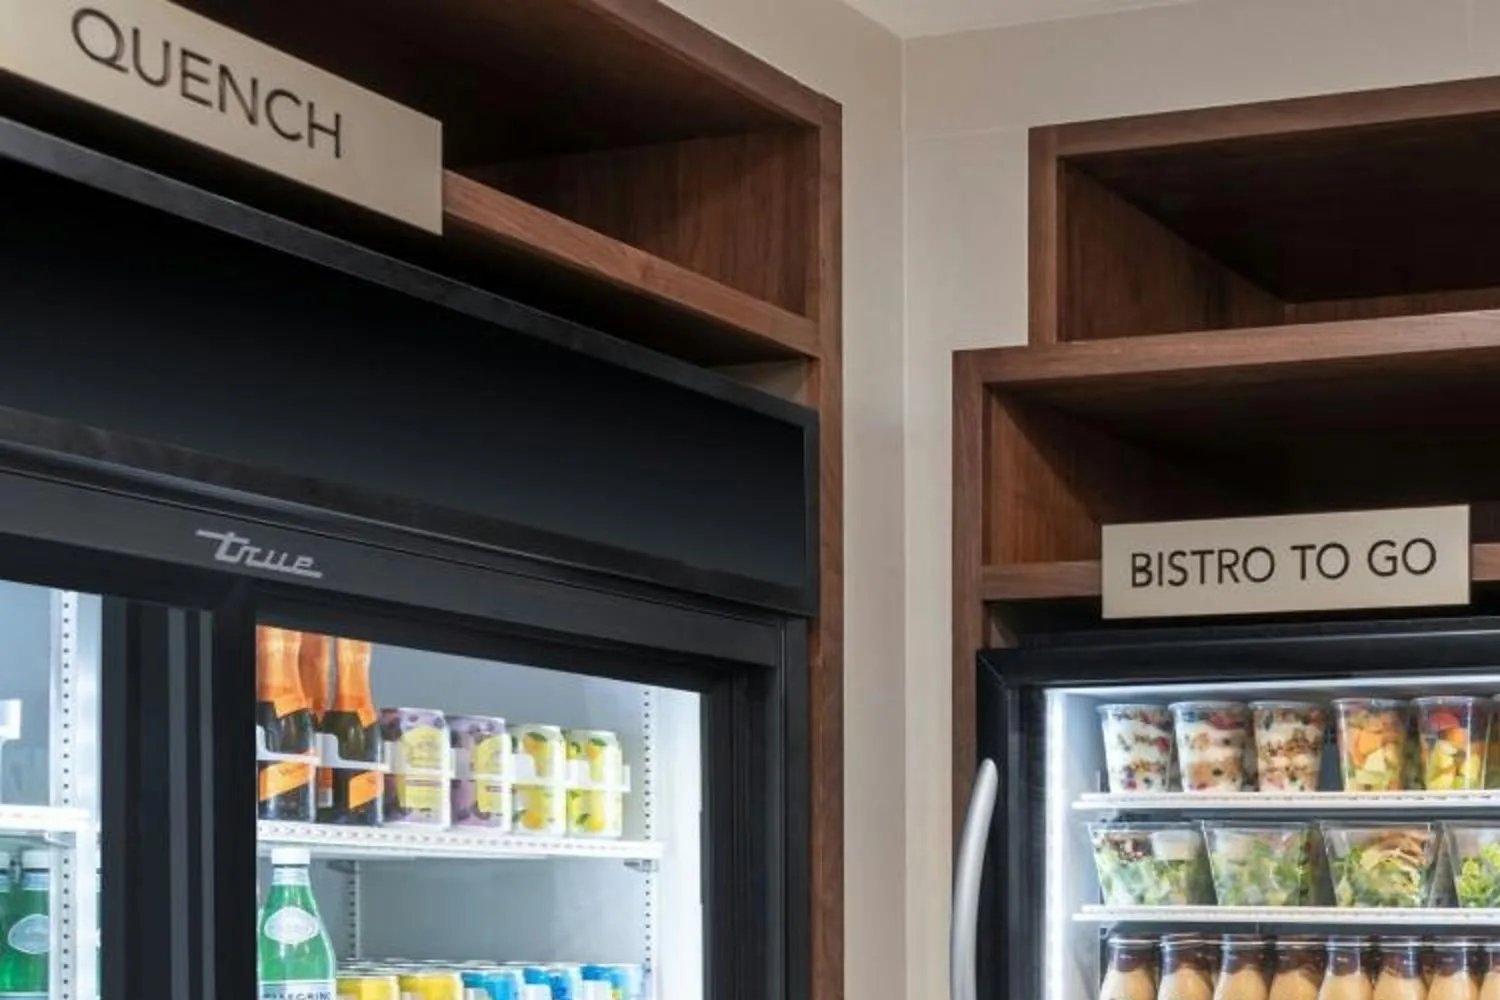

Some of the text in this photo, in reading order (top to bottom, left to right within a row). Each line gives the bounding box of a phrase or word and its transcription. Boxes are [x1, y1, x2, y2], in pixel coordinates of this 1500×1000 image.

[71, 8, 343, 159] QUENCH
[1131, 537, 1437, 588] BISTRO TO GO
